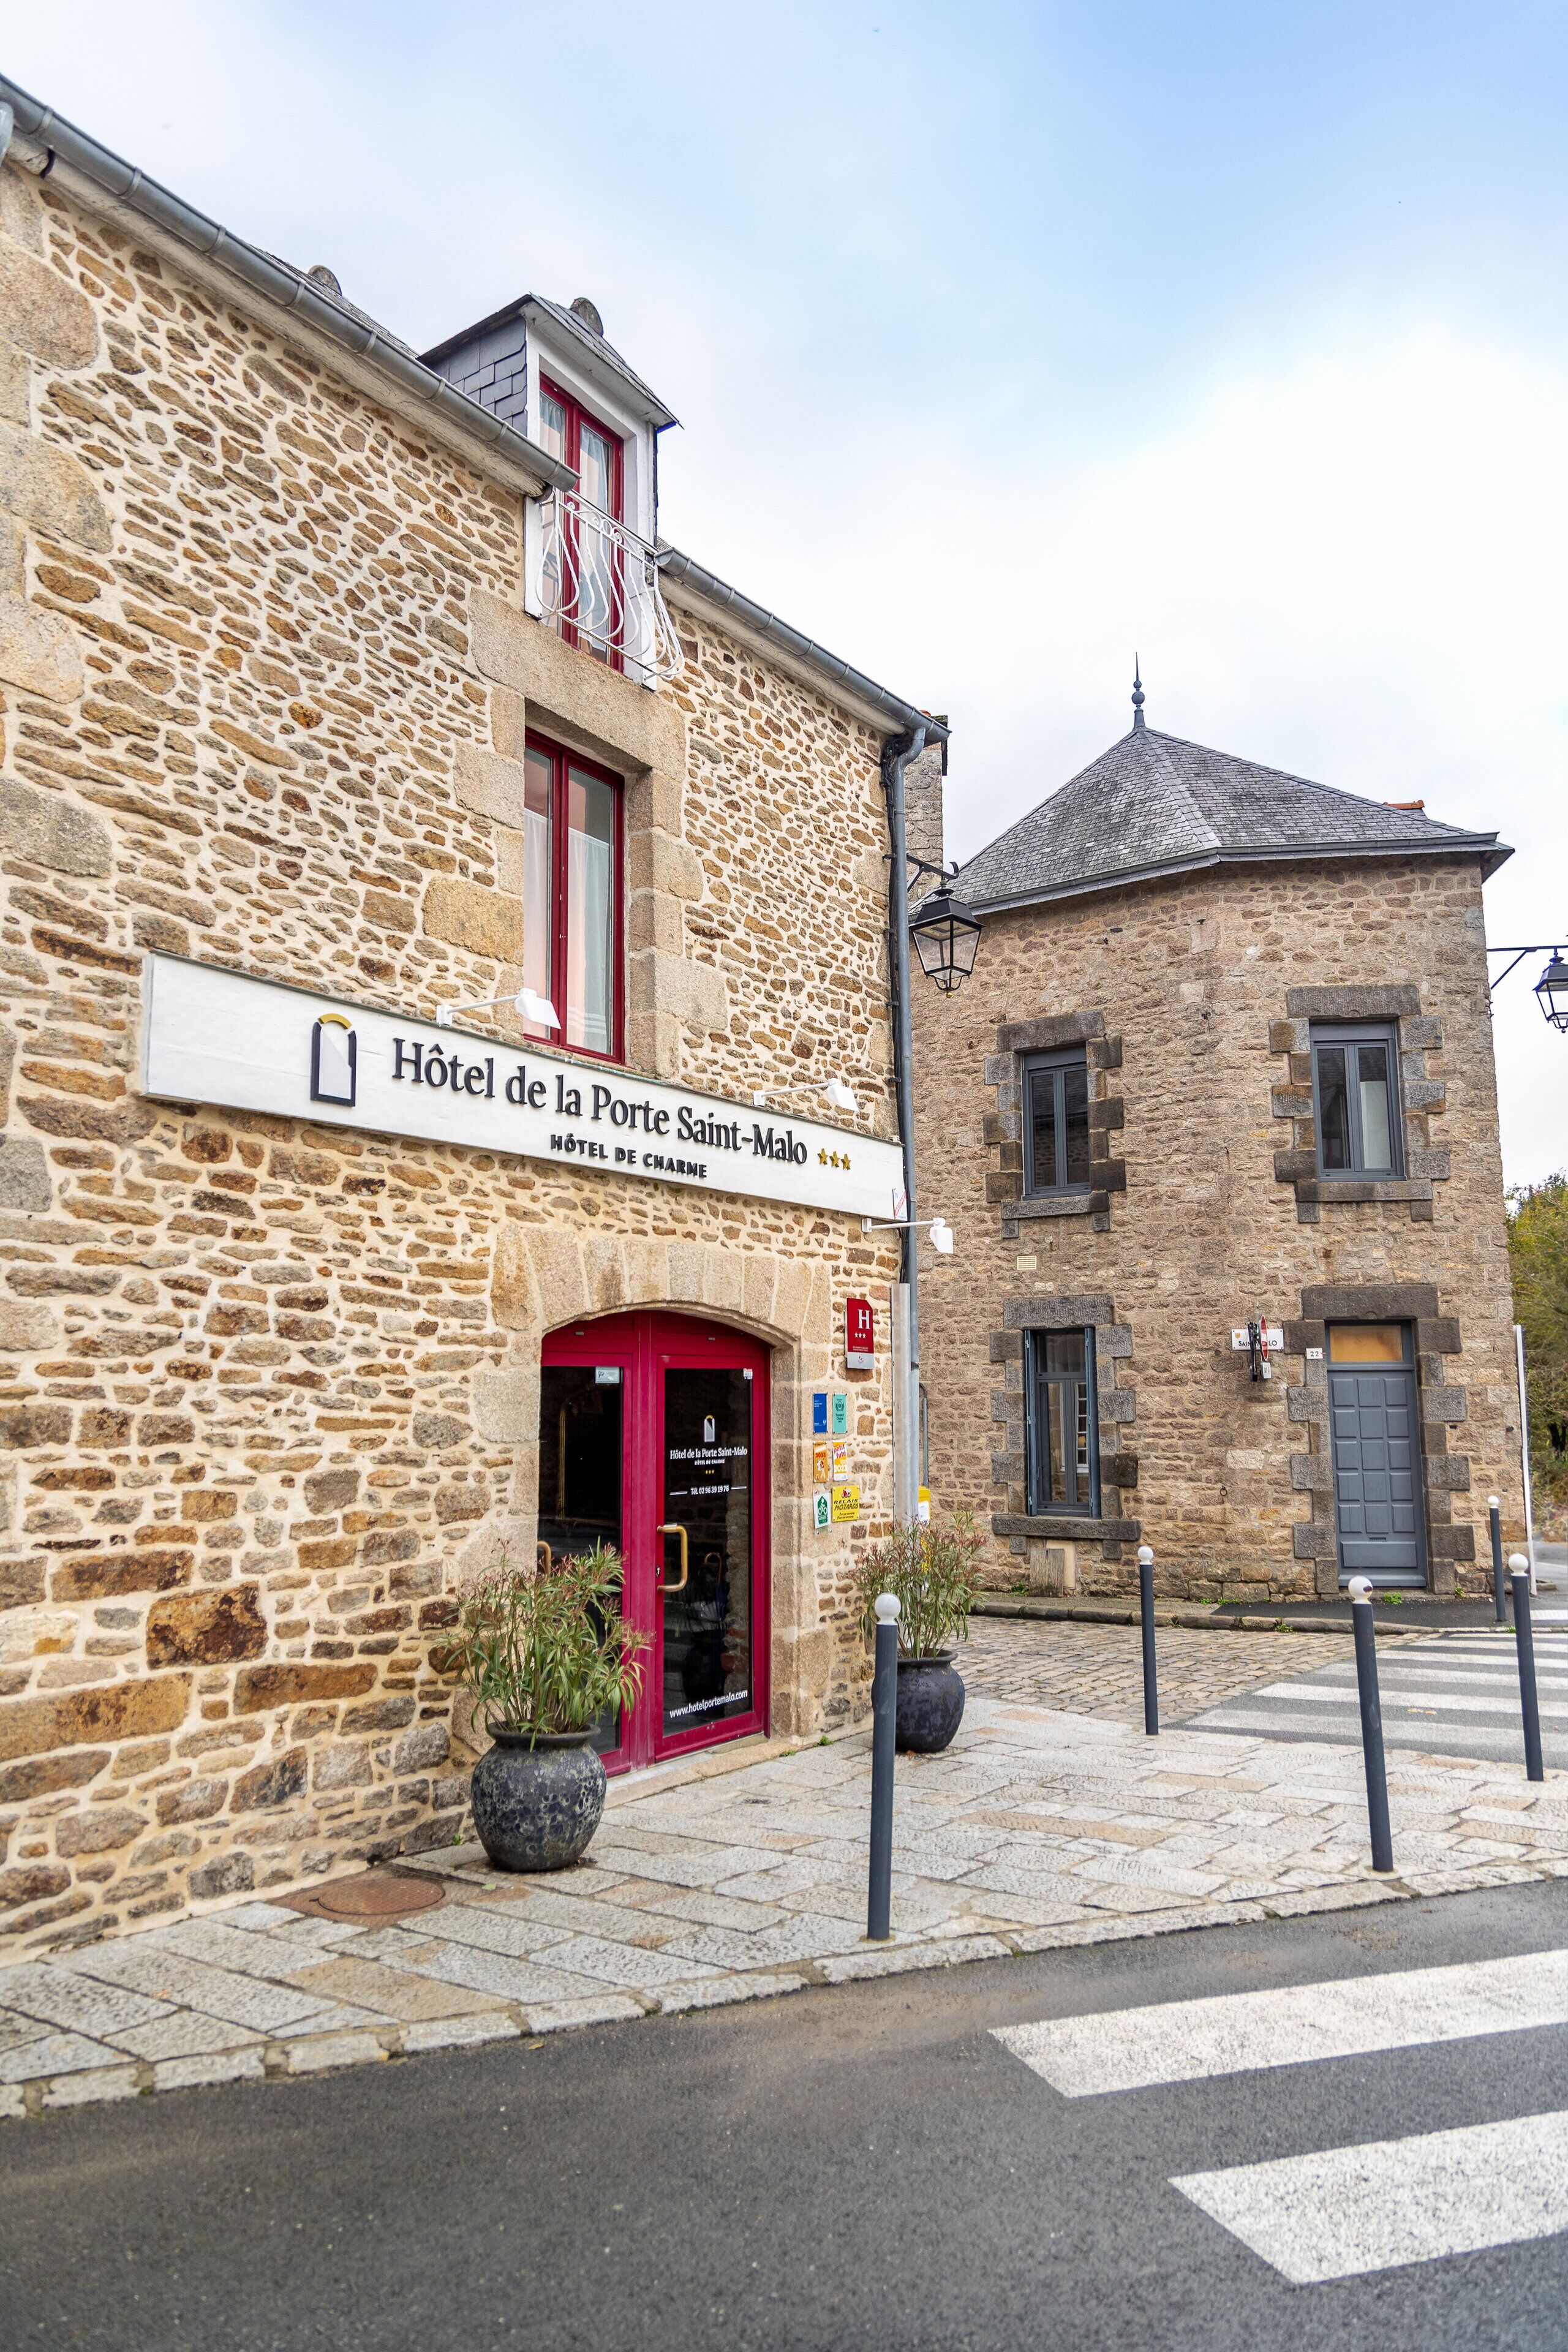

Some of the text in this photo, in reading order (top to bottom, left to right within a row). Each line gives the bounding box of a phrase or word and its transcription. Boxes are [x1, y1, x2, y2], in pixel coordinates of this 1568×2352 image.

[392, 1038, 808, 1164] Hôtel de la Porte Saint-Malo
[550, 1133, 707, 1178] HÔTEL DE CHARME
[858, 1308, 870, 1330] H
[669, 1446, 747, 1460] Hôtel de la Porte Saint-Malo
[834, 1443, 845, 1454] petit
[834, 1503, 859, 1512] MOTARDS
[669, 1689, 748, 1719] www.hotelportemalo.com
